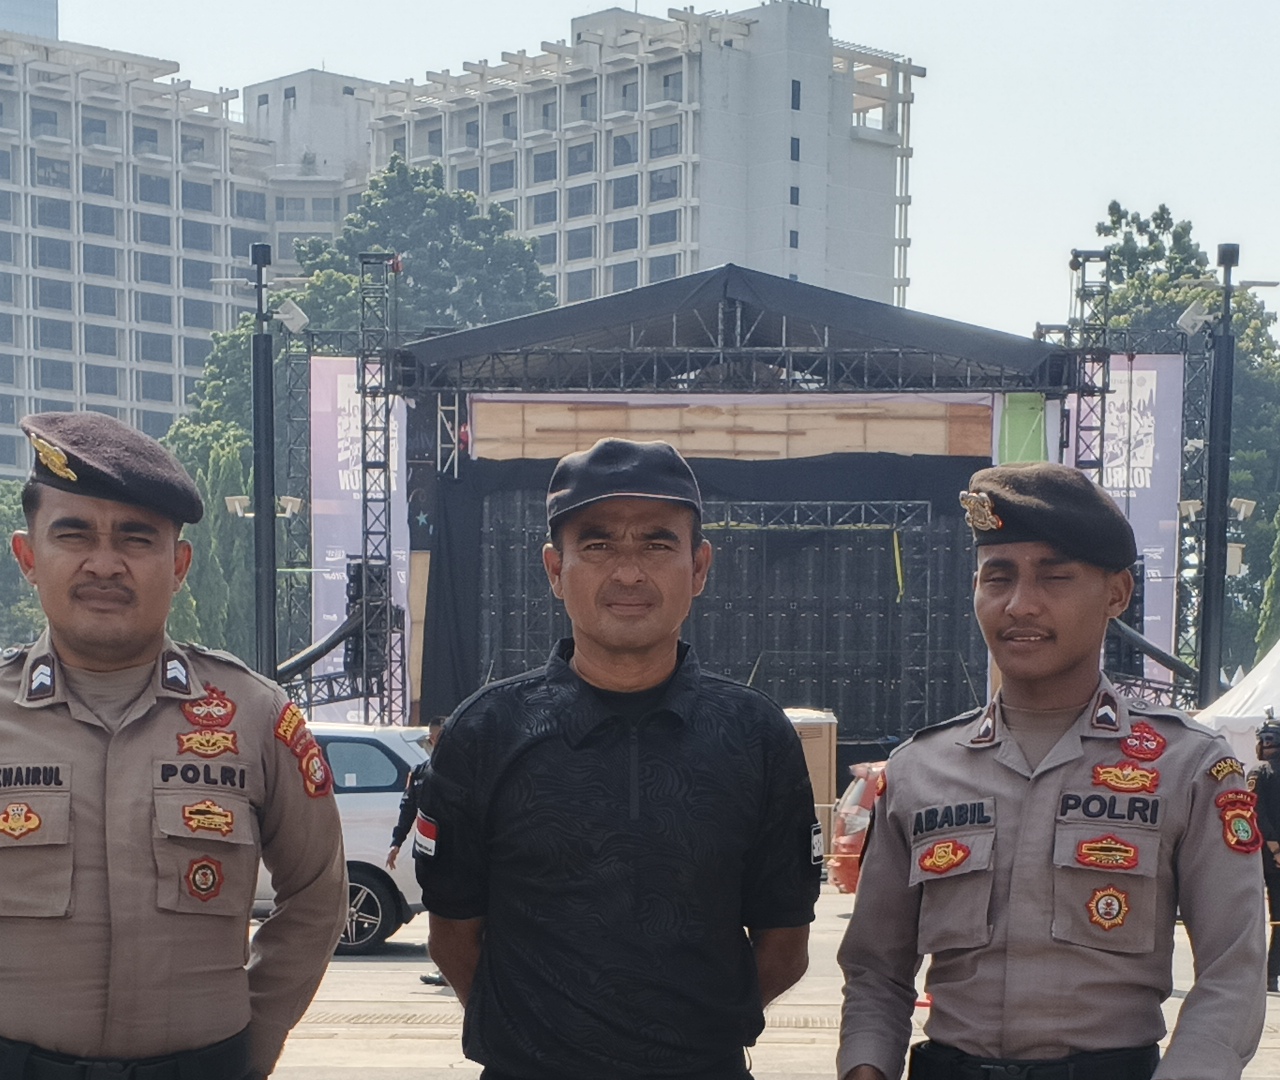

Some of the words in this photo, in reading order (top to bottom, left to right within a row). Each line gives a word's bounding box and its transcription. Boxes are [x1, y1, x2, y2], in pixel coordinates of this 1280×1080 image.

[161, 764, 246, 789] POLRI
[913, 802, 992, 836] ABABIL
[1060, 794, 1160, 825] POLRI
